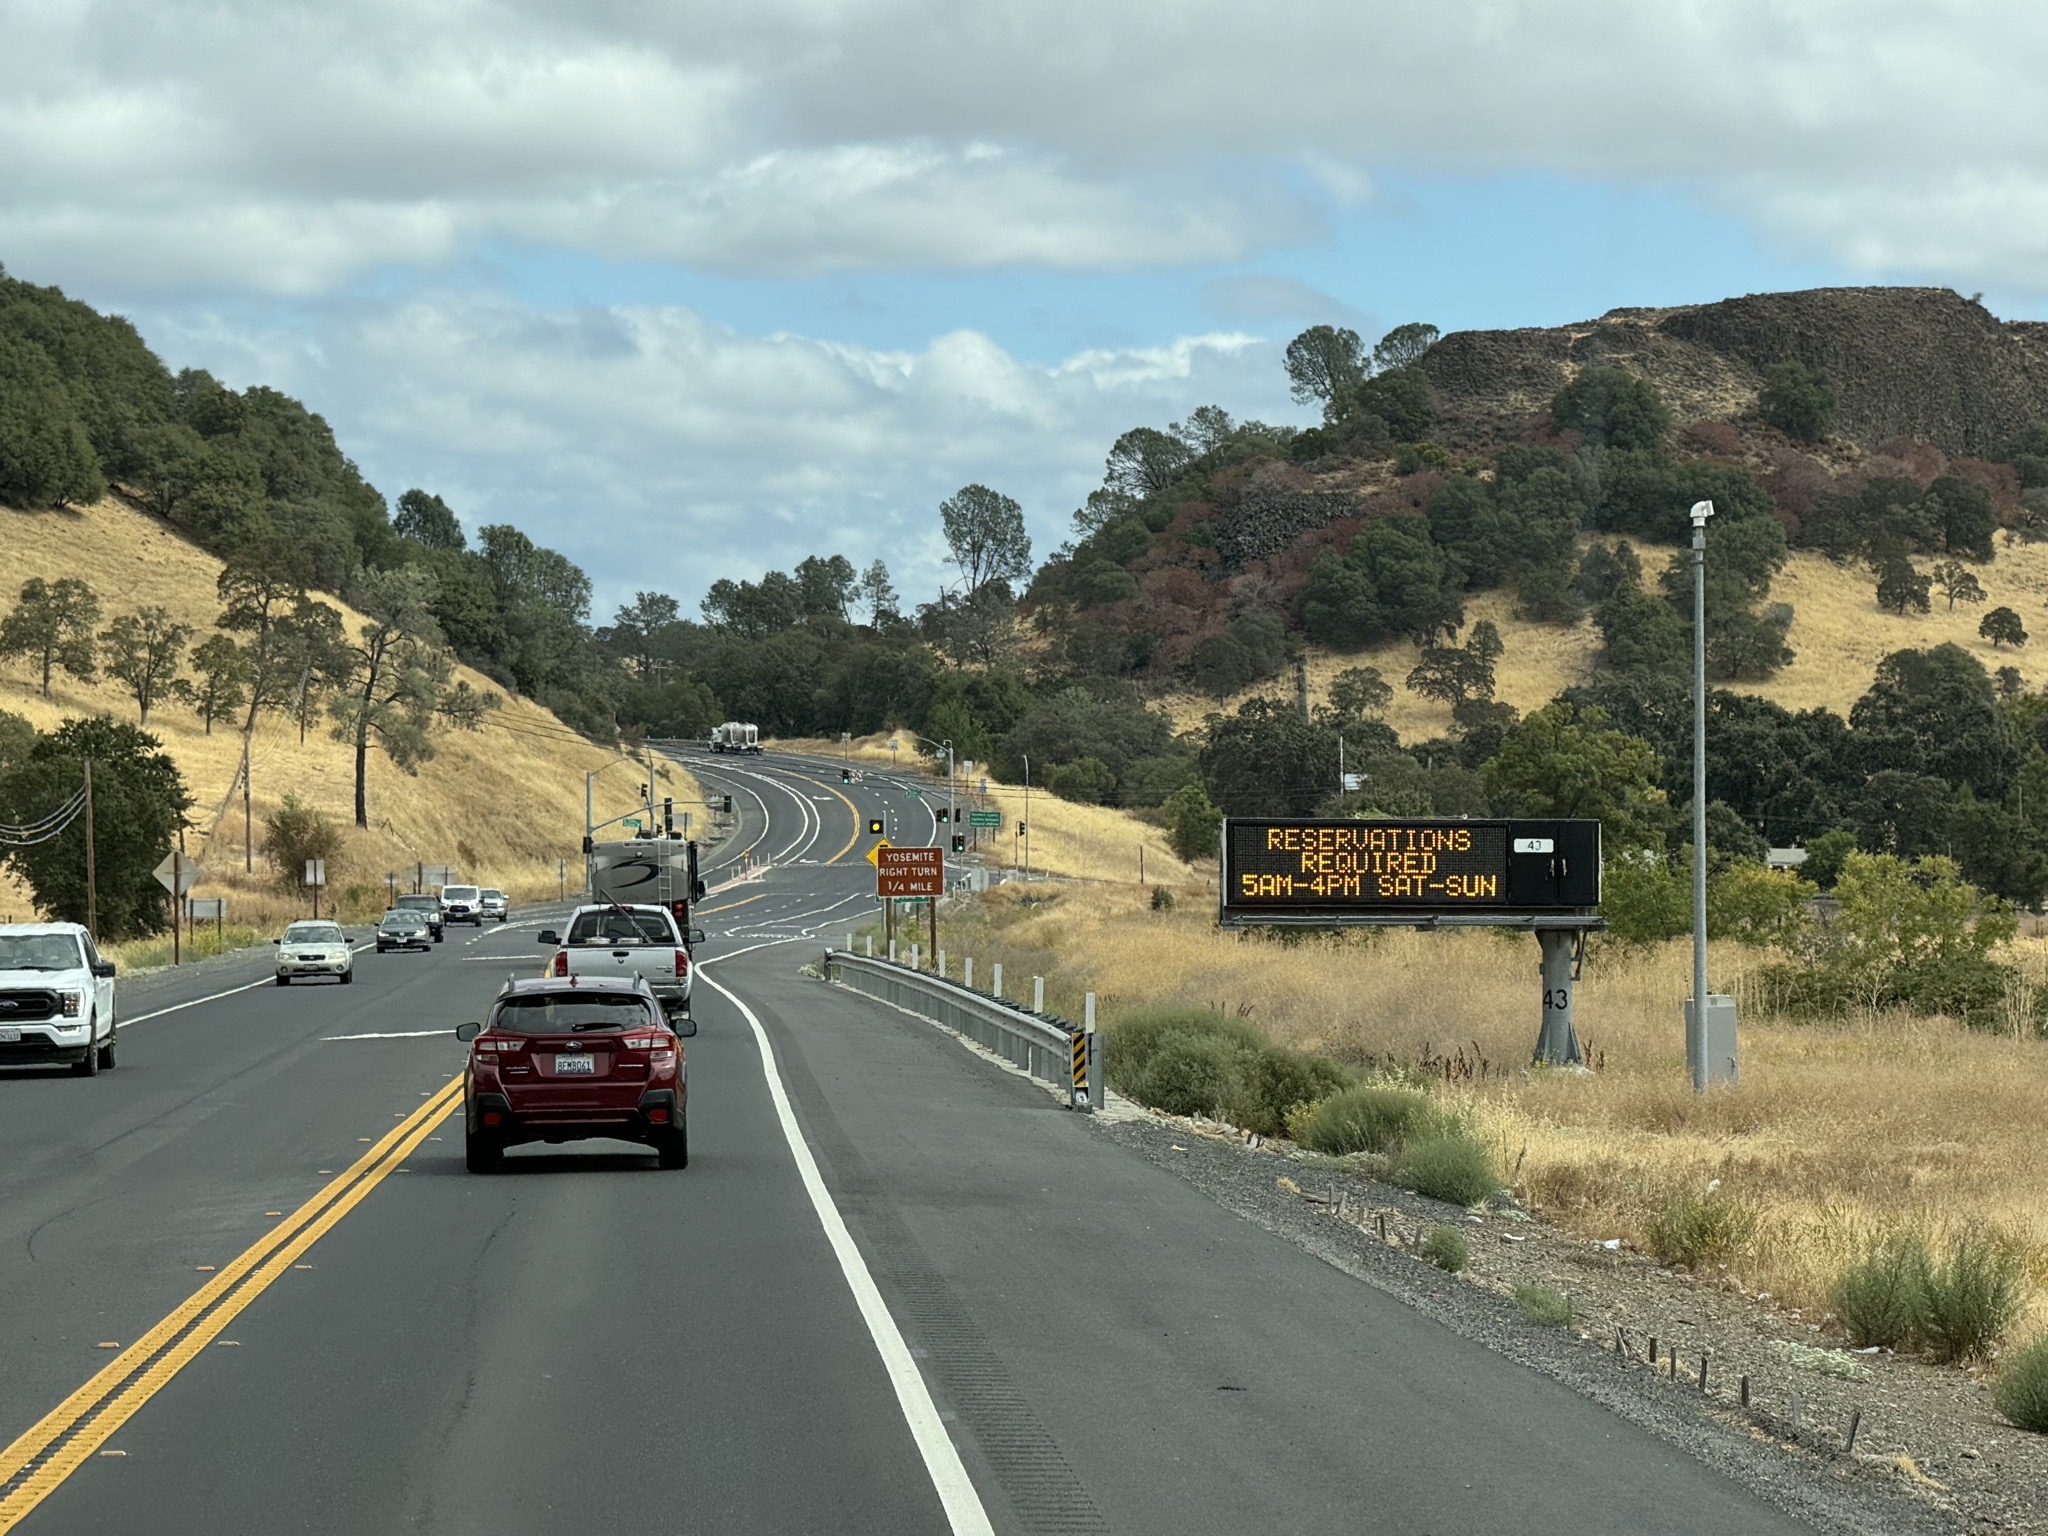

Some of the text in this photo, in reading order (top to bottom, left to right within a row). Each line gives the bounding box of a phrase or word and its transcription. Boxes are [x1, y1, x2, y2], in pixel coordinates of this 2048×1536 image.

[1268, 829, 1471, 850] RESERVATIONS
[1527, 840, 1542, 851] 43
[886, 852, 935, 862] YOSEMITE
[1301, 852, 1436, 873] REQUIRED
[879, 867, 937, 877] RIGHT TURN
[888, 881, 933, 892] 1/4 MILE
[1242, 874, 1496, 896] 5AM-4PM SAT-SUN
[1543, 989, 1568, 1010] 43
